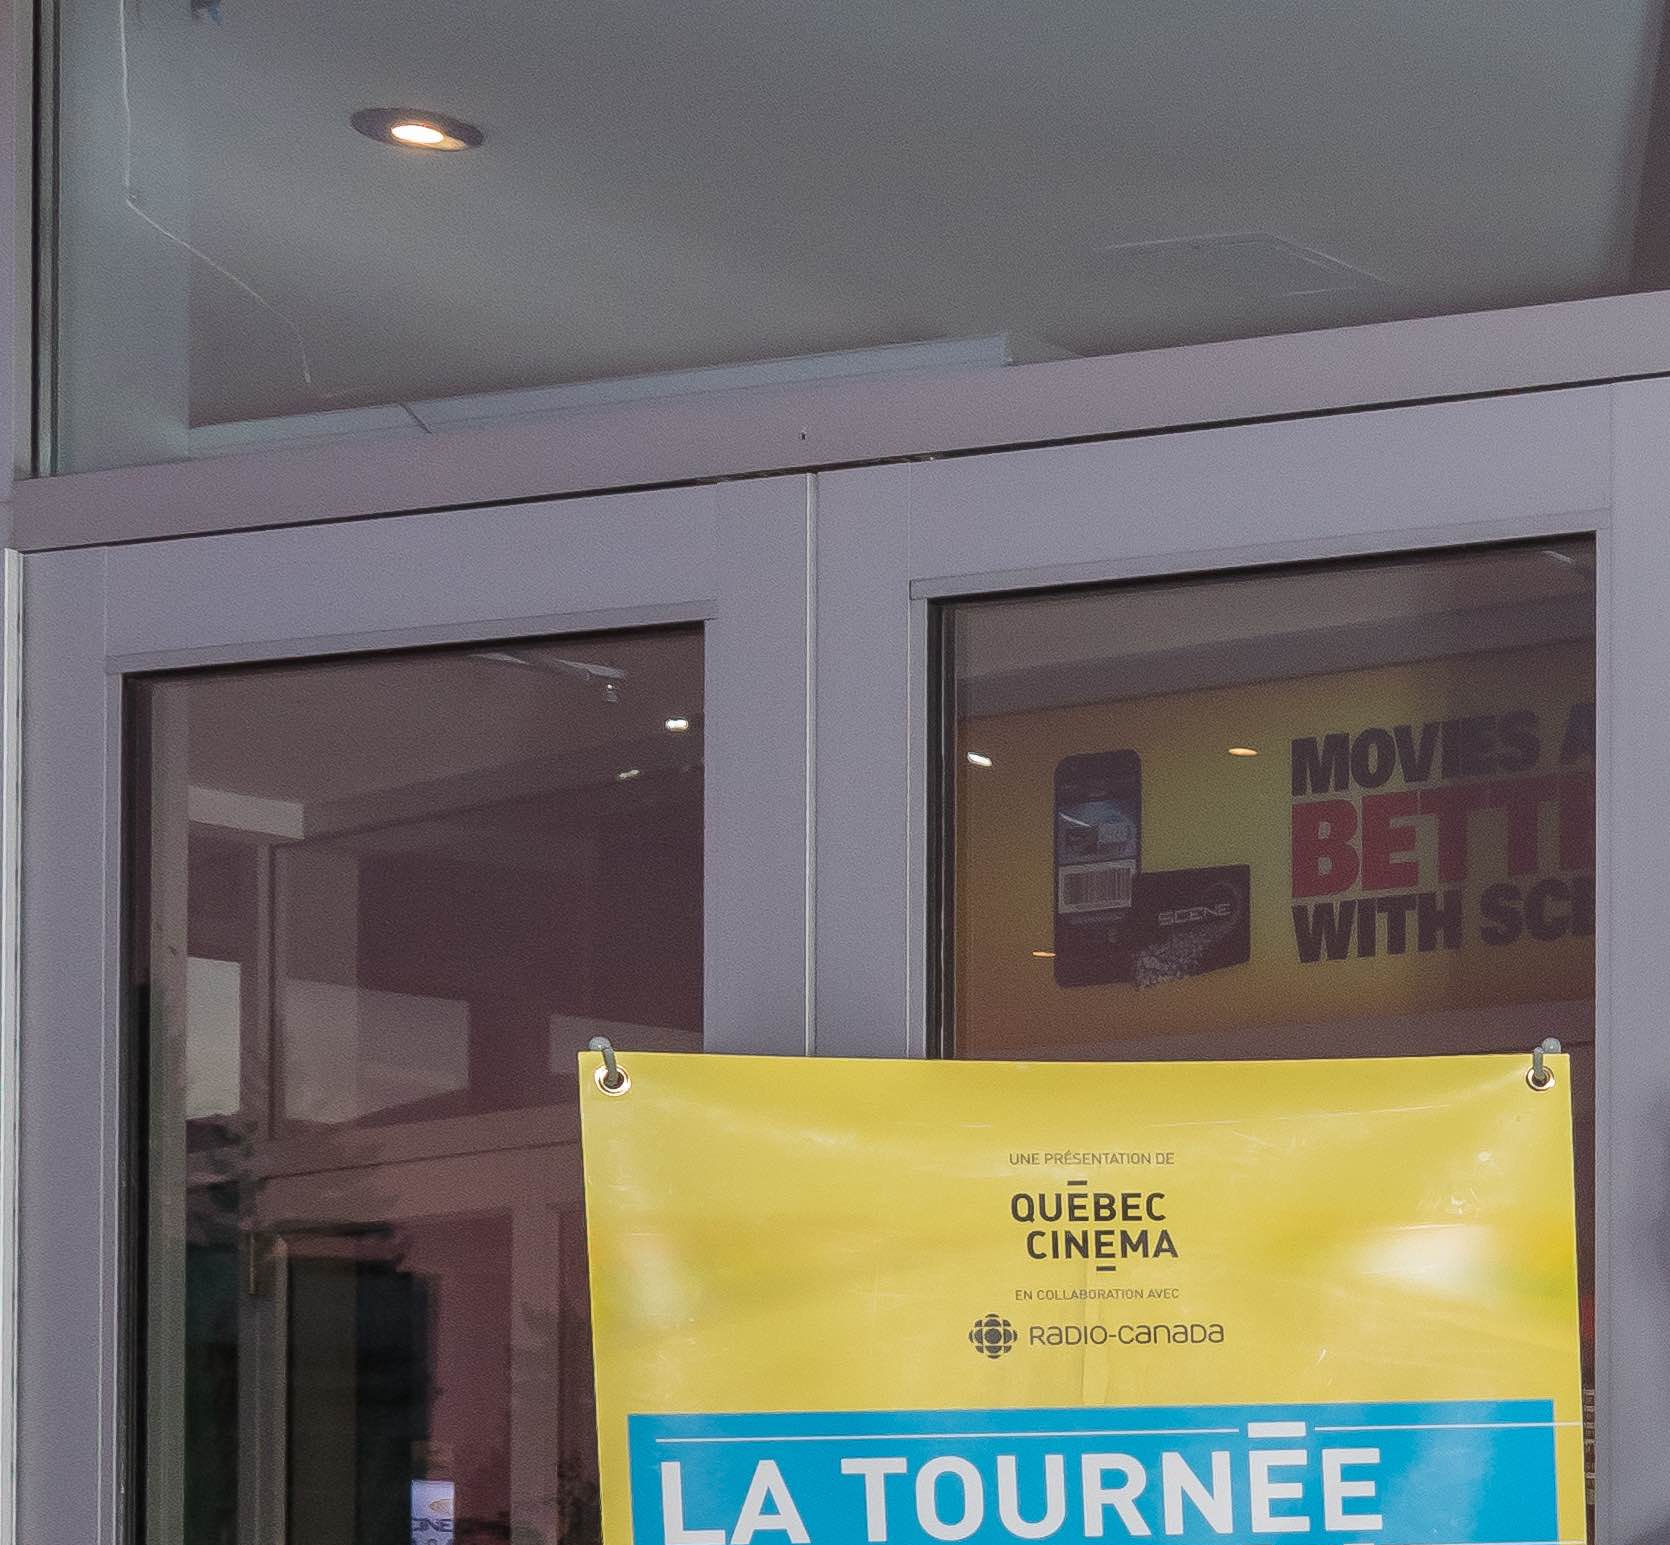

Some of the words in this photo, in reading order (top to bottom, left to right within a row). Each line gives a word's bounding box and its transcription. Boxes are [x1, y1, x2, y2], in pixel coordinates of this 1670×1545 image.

[1291, 710, 1539, 797] MOVIES
[1291, 889, 1463, 963] WITH
[1009, 1153, 1039, 1165] UNE
[1044, 1150, 1151, 1165] PRÉSENTATION
[1156, 1152, 1175, 1164] DE
[1015, 1289, 1033, 1300] EN
[1037, 1289, 1143, 1300] COLLABORATION
[1147, 1288, 1180, 1299] AVEC
